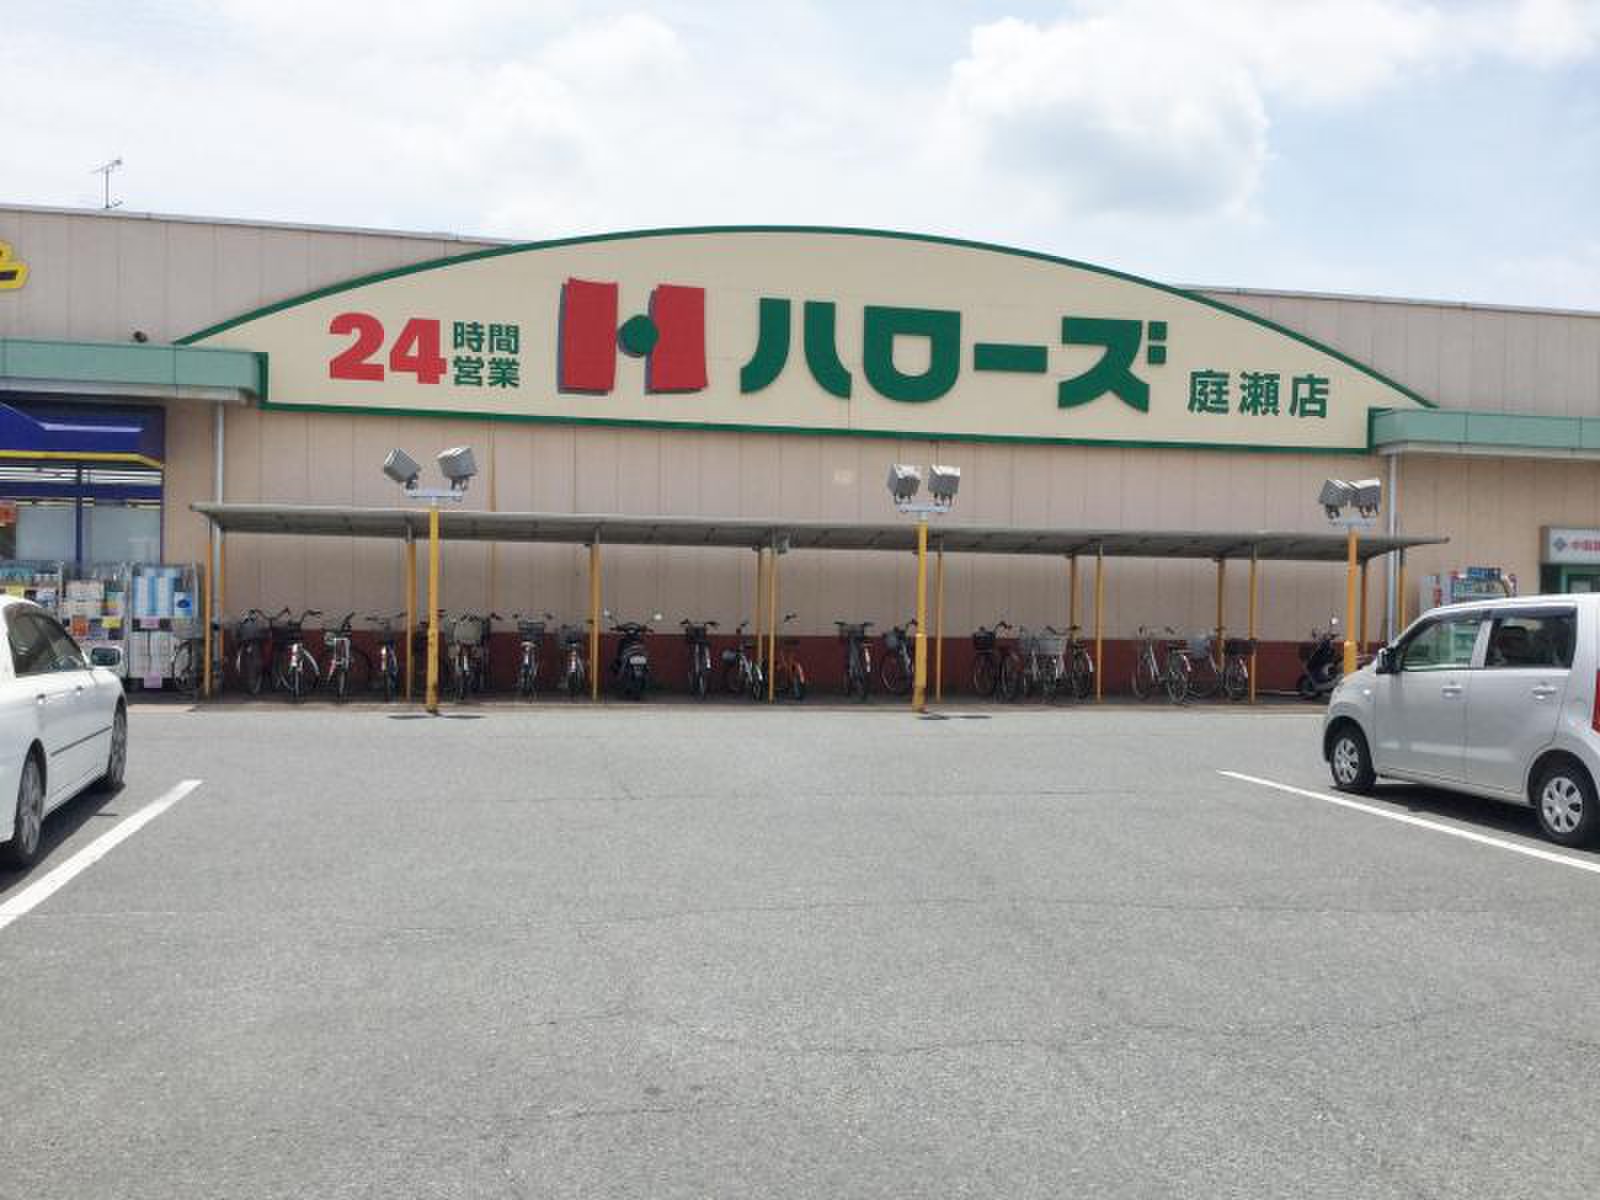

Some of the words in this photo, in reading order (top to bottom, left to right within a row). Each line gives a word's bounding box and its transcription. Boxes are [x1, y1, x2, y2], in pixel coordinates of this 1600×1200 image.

[329, 313, 447, 384] 24
[453, 321, 520, 355] 時間
[740, 298, 1167, 412] ハローズ
[453, 356, 520, 389] 営業
[1187, 370, 1330, 419] 庭瀬店
